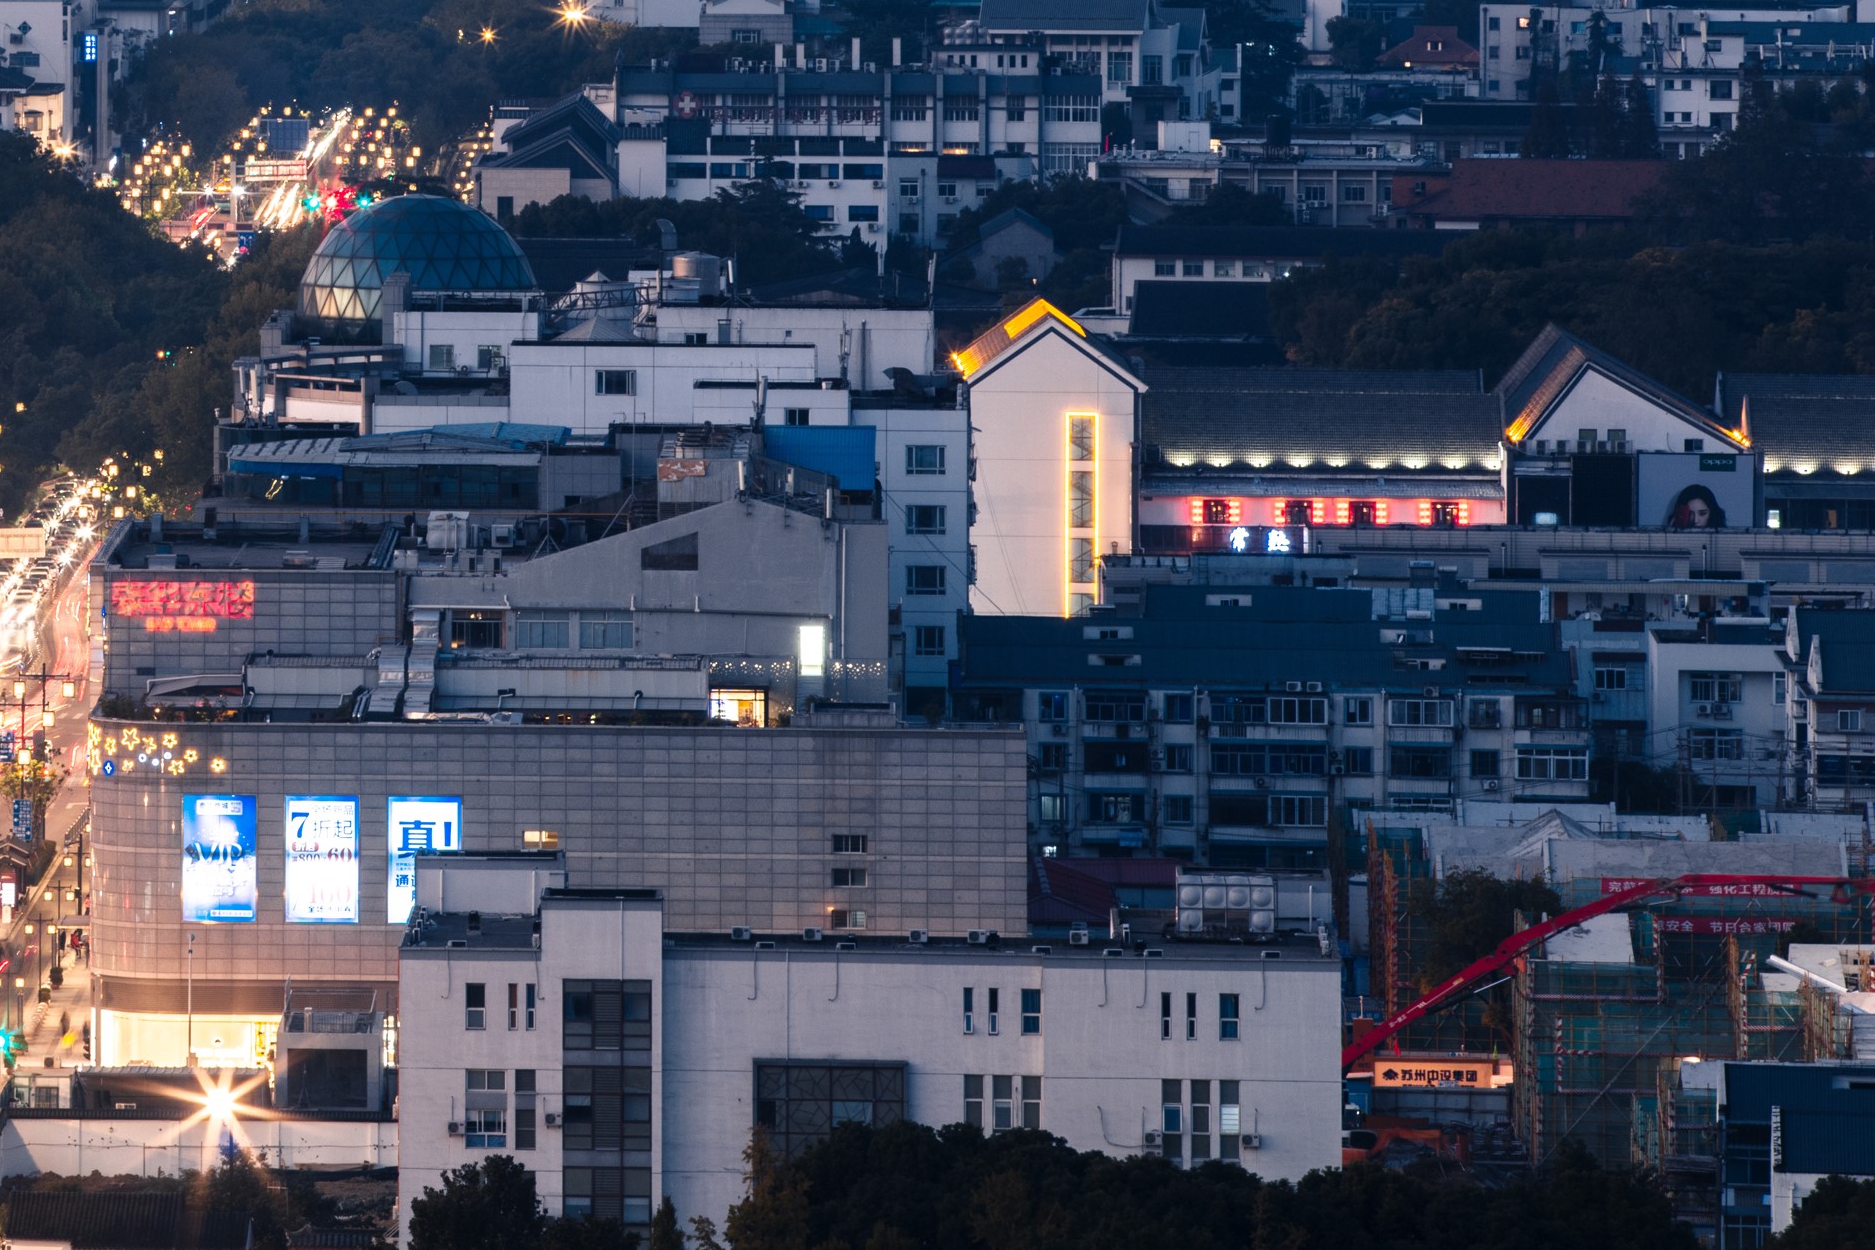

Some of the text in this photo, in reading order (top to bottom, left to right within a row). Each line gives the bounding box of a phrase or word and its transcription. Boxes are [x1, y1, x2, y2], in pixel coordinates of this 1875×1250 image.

[192, 842, 243, 864] VIP
[1400, 1068, 1478, 1082] 苏州中设集团
